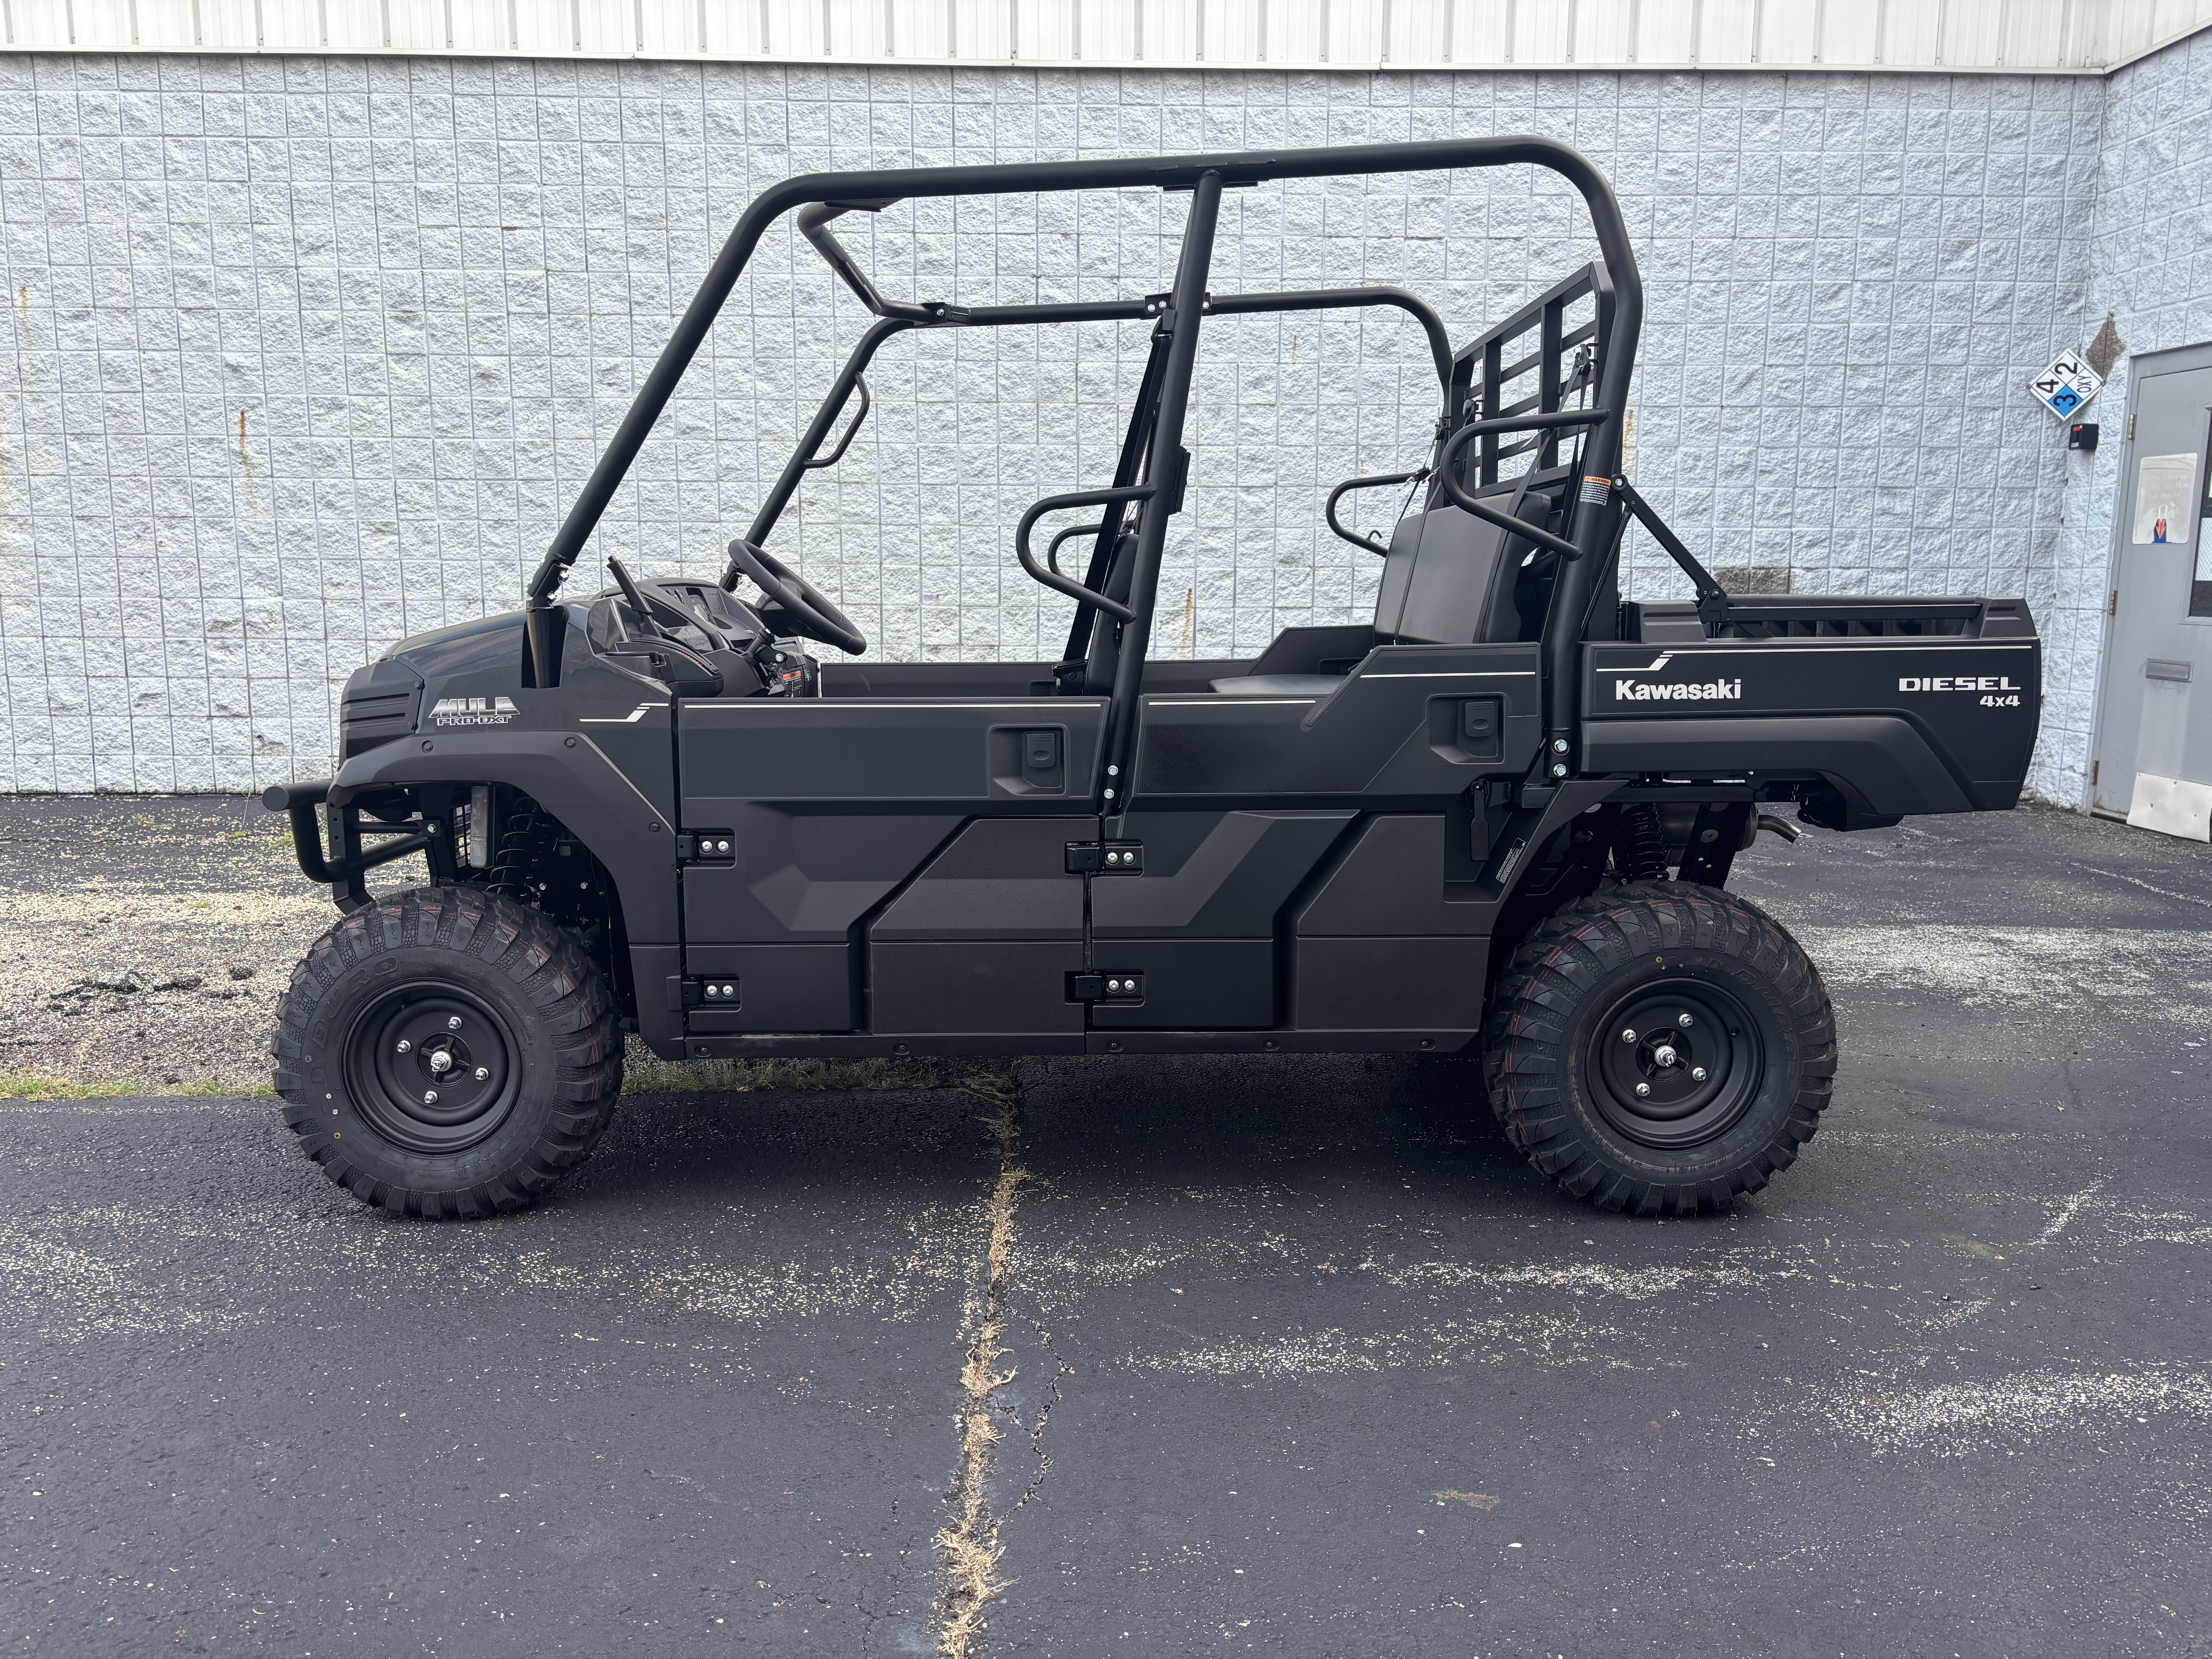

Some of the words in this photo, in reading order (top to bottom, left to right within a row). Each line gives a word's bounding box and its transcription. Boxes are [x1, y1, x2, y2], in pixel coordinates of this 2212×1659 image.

[2054, 362, 2078, 374] 2
[2036, 379, 2059, 393] 4
[2077, 375, 2092, 393] OXY
[2053, 394, 2077, 407] 3
[1616, 678, 1741, 700] Kawasaki
[1899, 677, 2021, 692] DIESEL
[429, 697, 520, 718] MULE
[1980, 695, 2020, 707] 4x4
[437, 715, 512, 726] PRO-DXT
